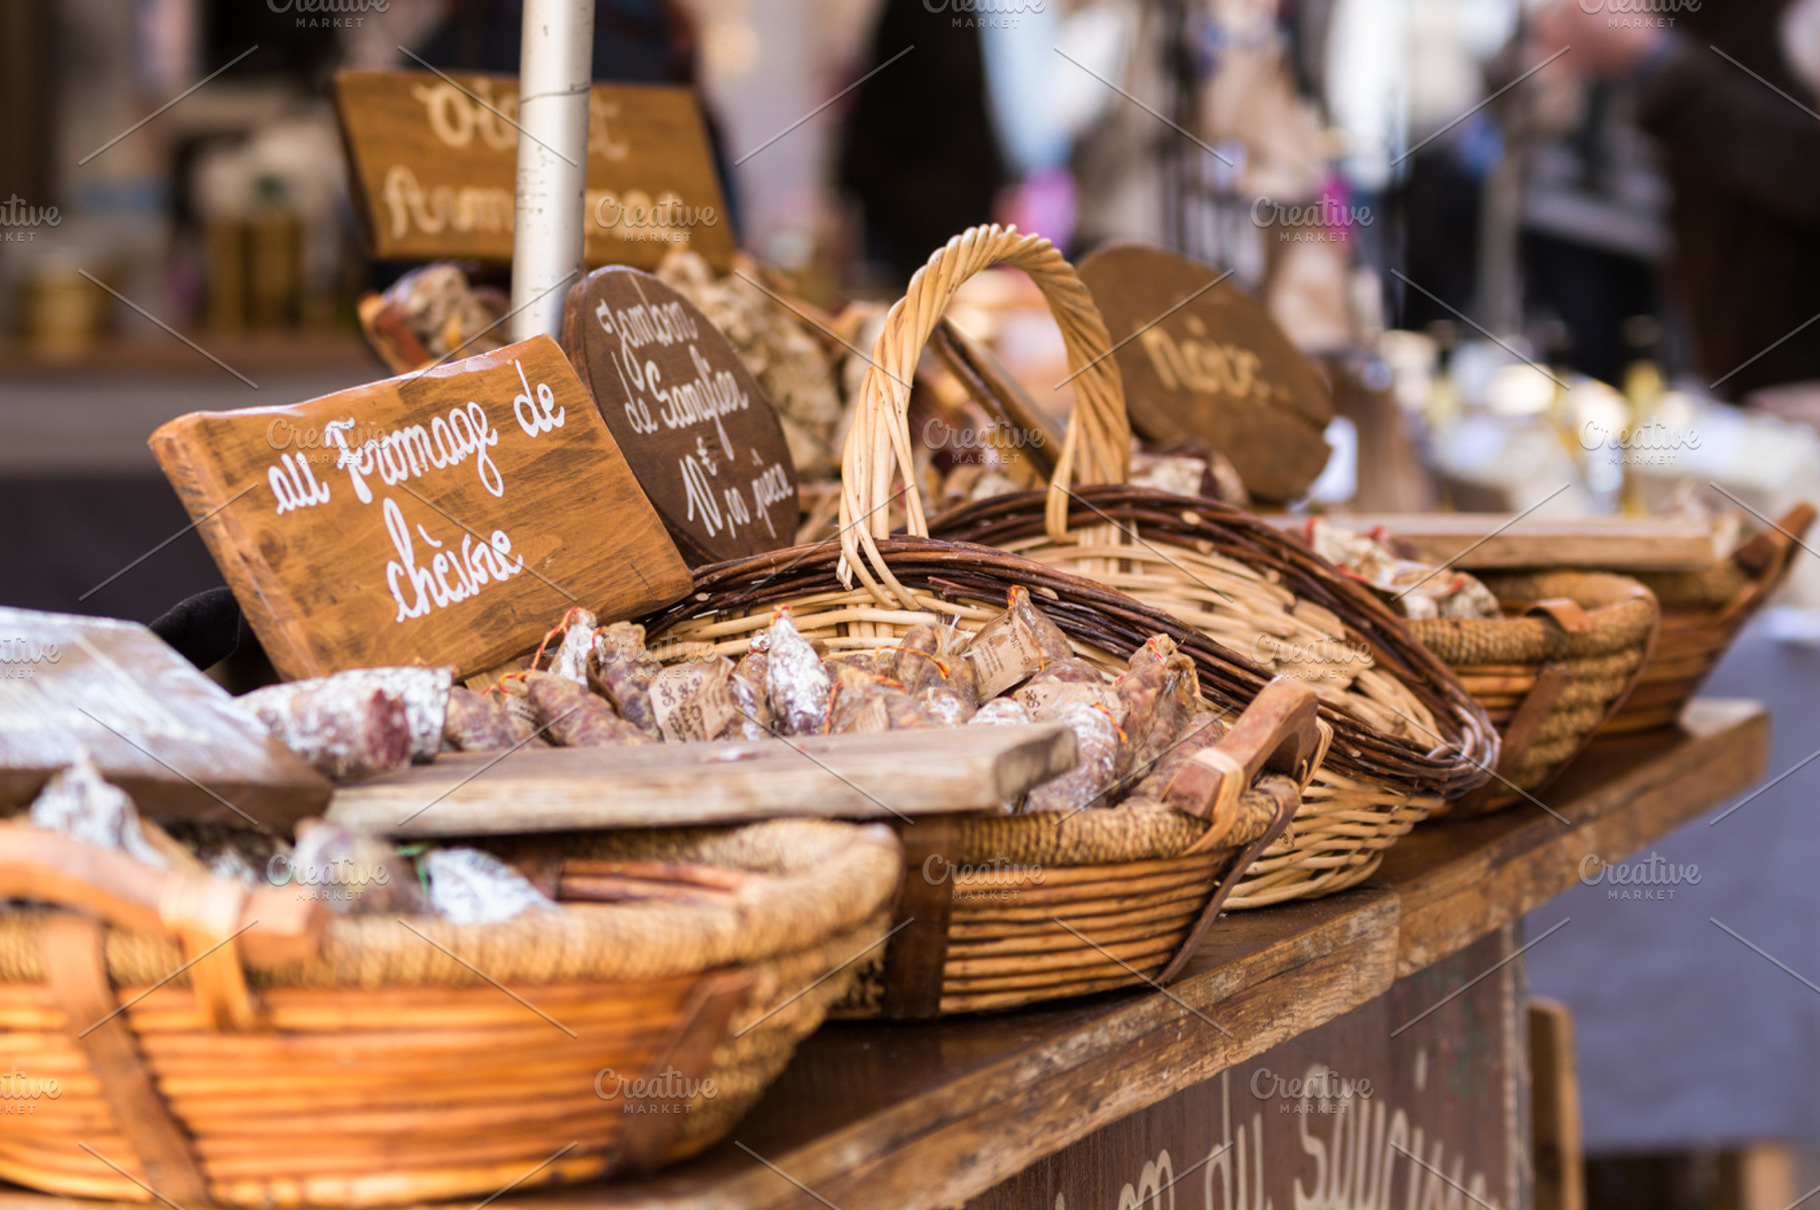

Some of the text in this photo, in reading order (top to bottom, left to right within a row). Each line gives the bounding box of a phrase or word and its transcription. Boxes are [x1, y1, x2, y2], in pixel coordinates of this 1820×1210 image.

[267, 359, 566, 515] au Fromage de
[610, 351, 659, 434] de
[382, 497, 524, 623] chèvre
